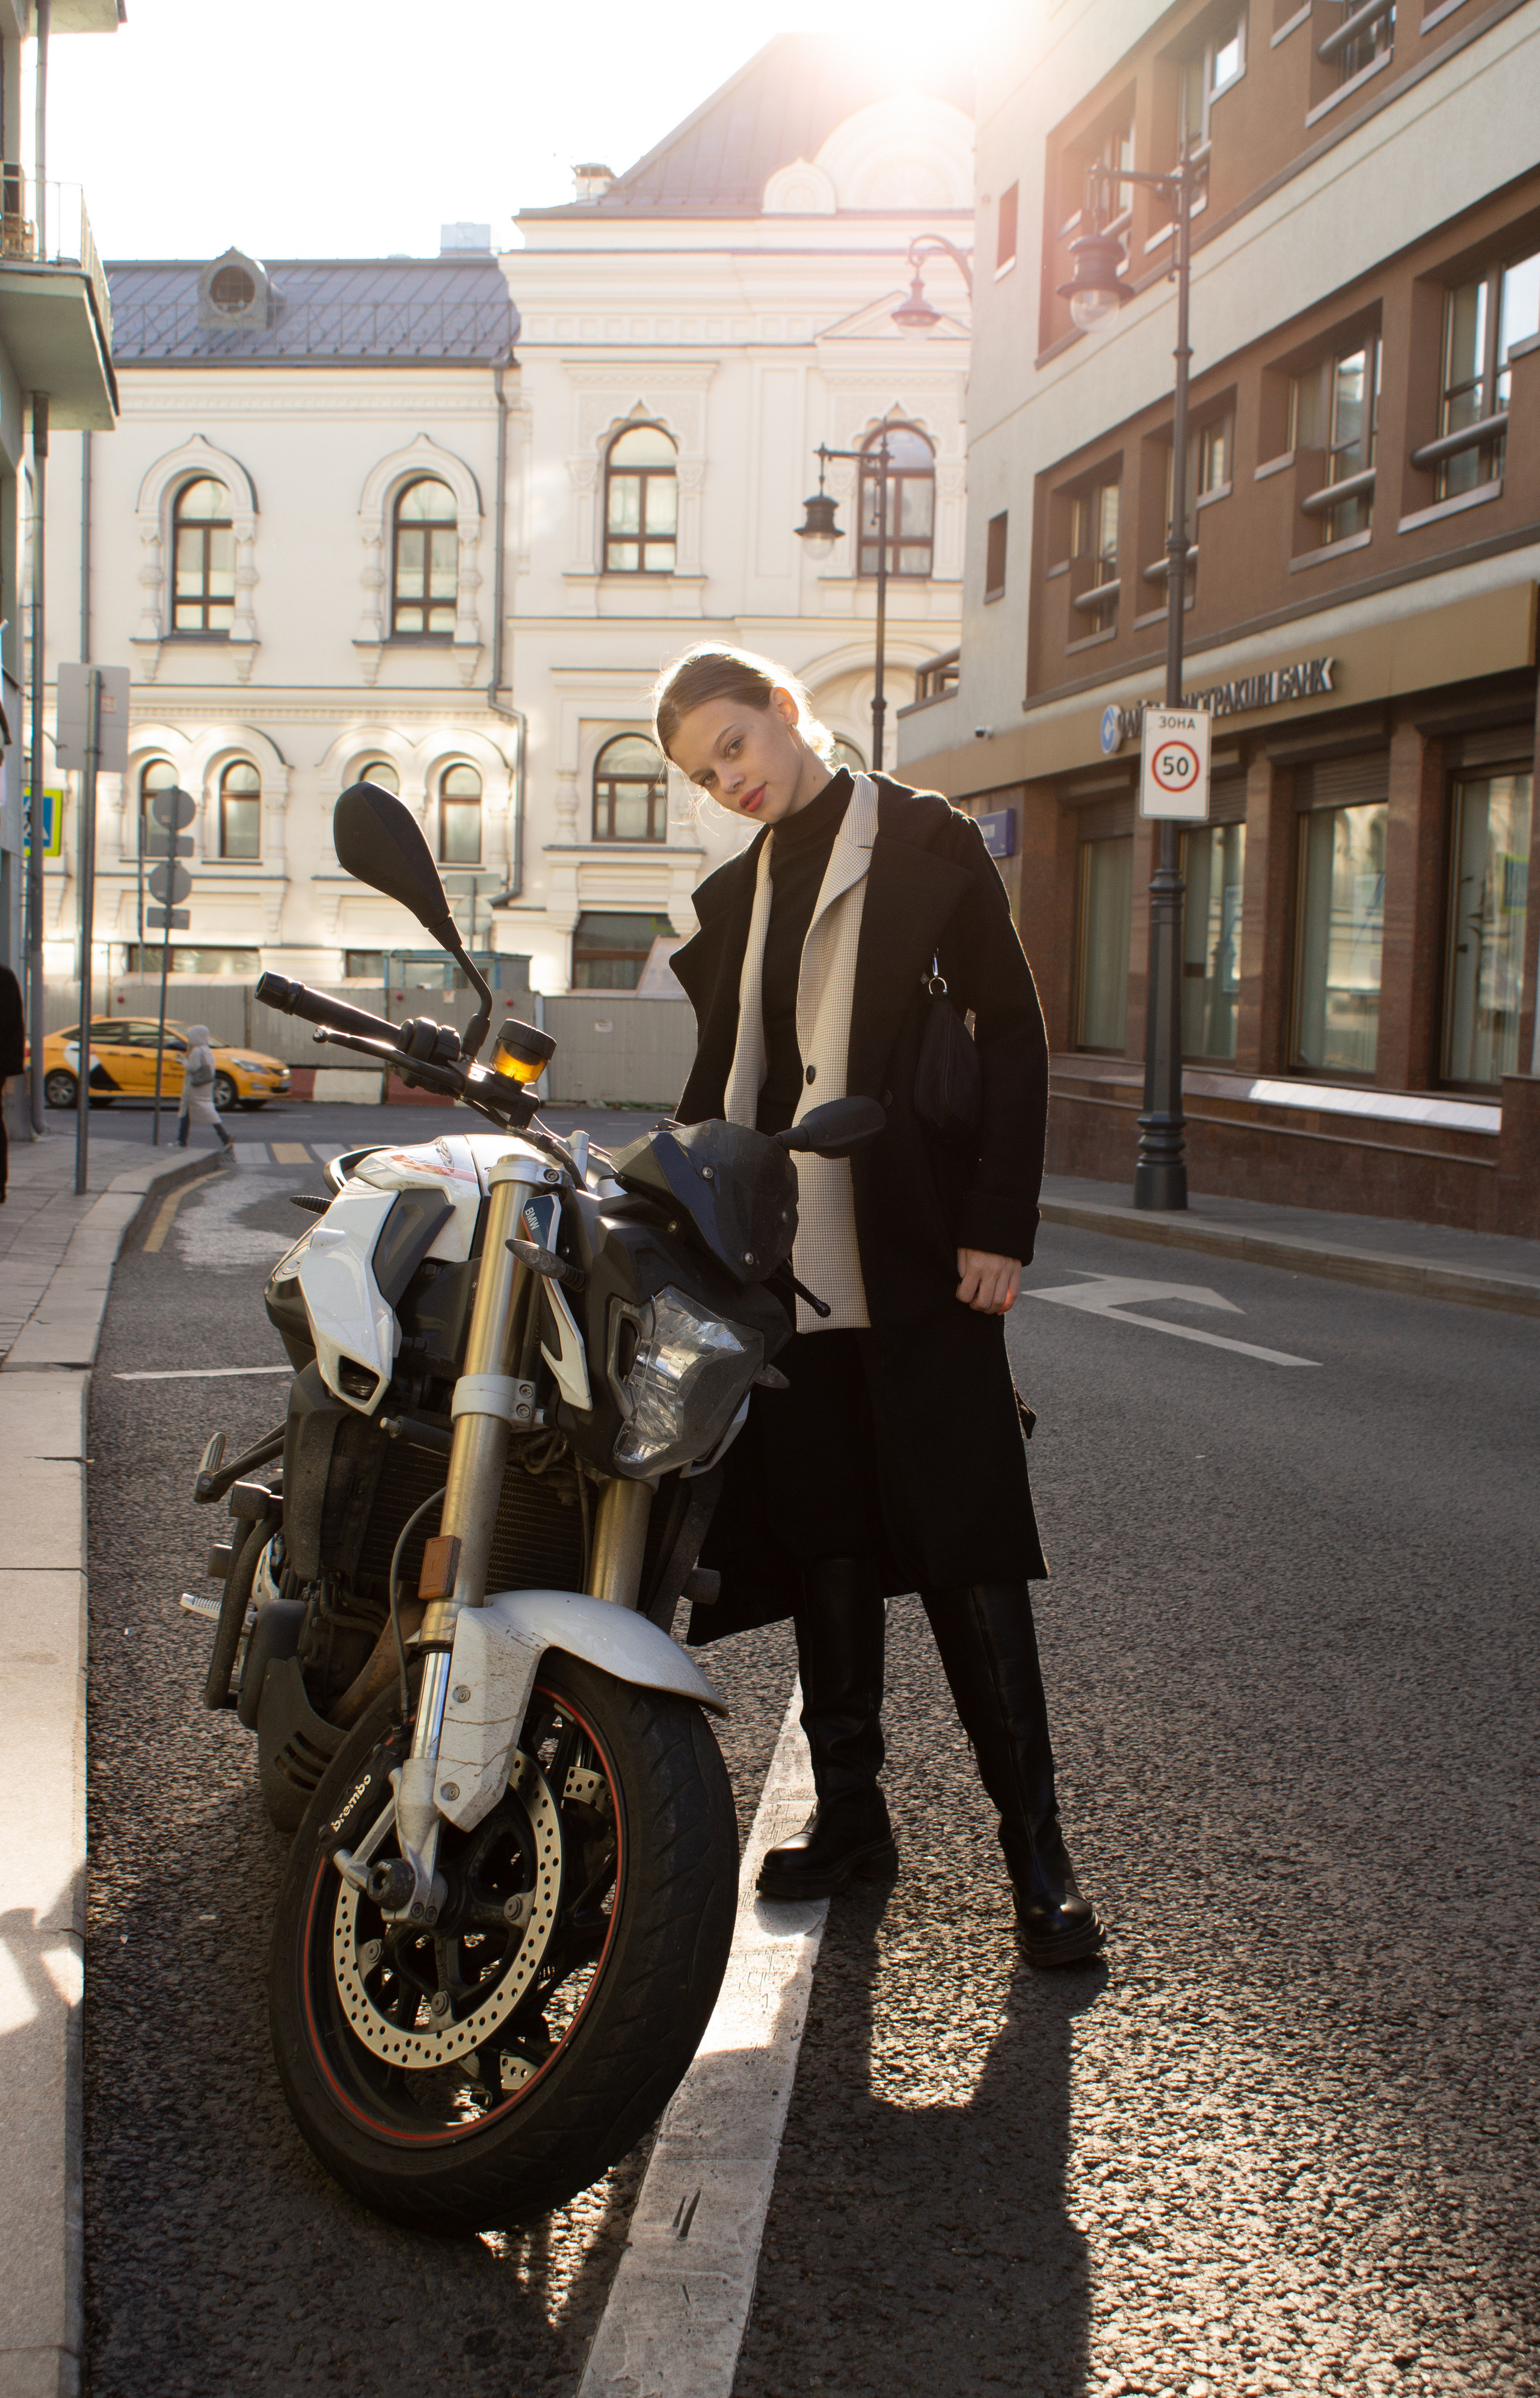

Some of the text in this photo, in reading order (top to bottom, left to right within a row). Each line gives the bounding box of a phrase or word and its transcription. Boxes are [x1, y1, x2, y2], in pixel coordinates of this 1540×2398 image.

[1278, 657, 1335, 702] БАНК
[1159, 715, 1196, 729] ЗОНА
[1163, 756, 1189, 776] 50
[525, 1207, 540, 1231] BMW
[331, 1774, 372, 1832] brembo
